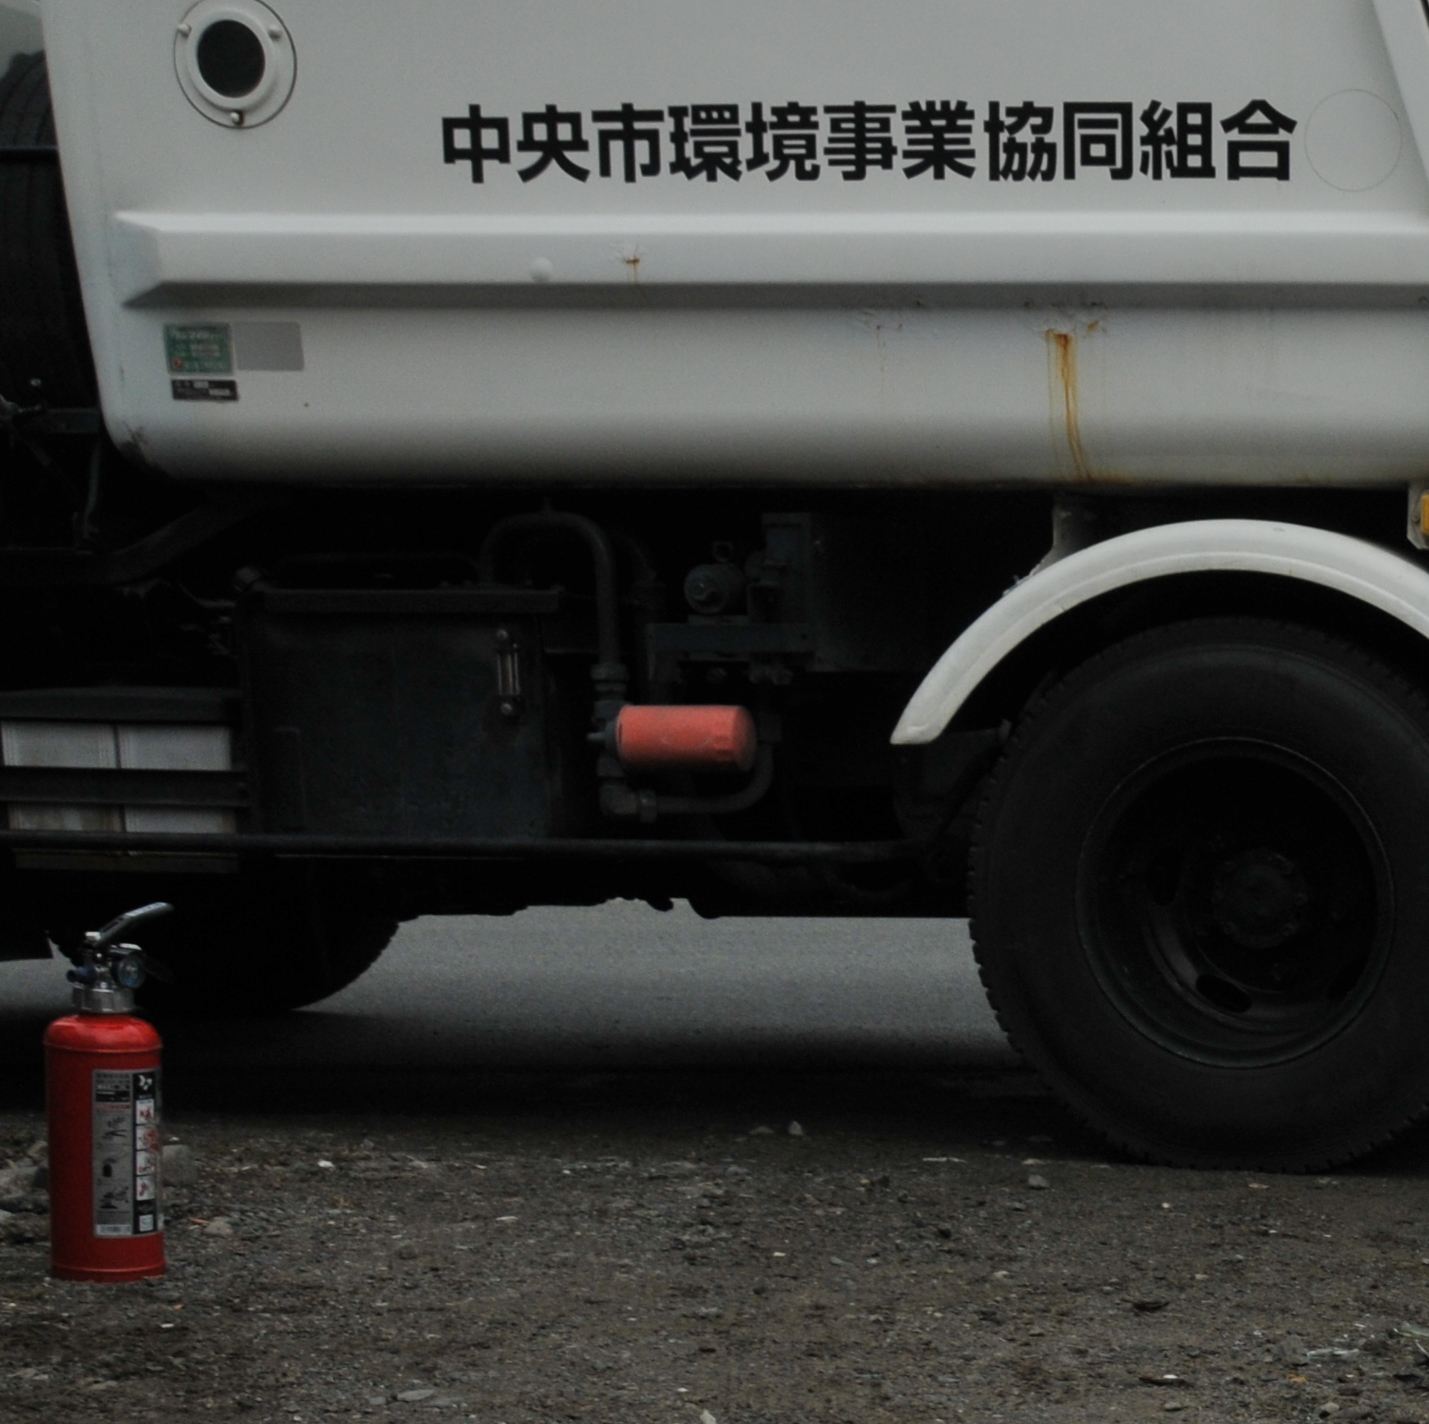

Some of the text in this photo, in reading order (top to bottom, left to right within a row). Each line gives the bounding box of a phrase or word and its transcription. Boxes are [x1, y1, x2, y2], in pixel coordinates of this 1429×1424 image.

[441, 100, 1298, 184] 中央市環境事業協同組合
